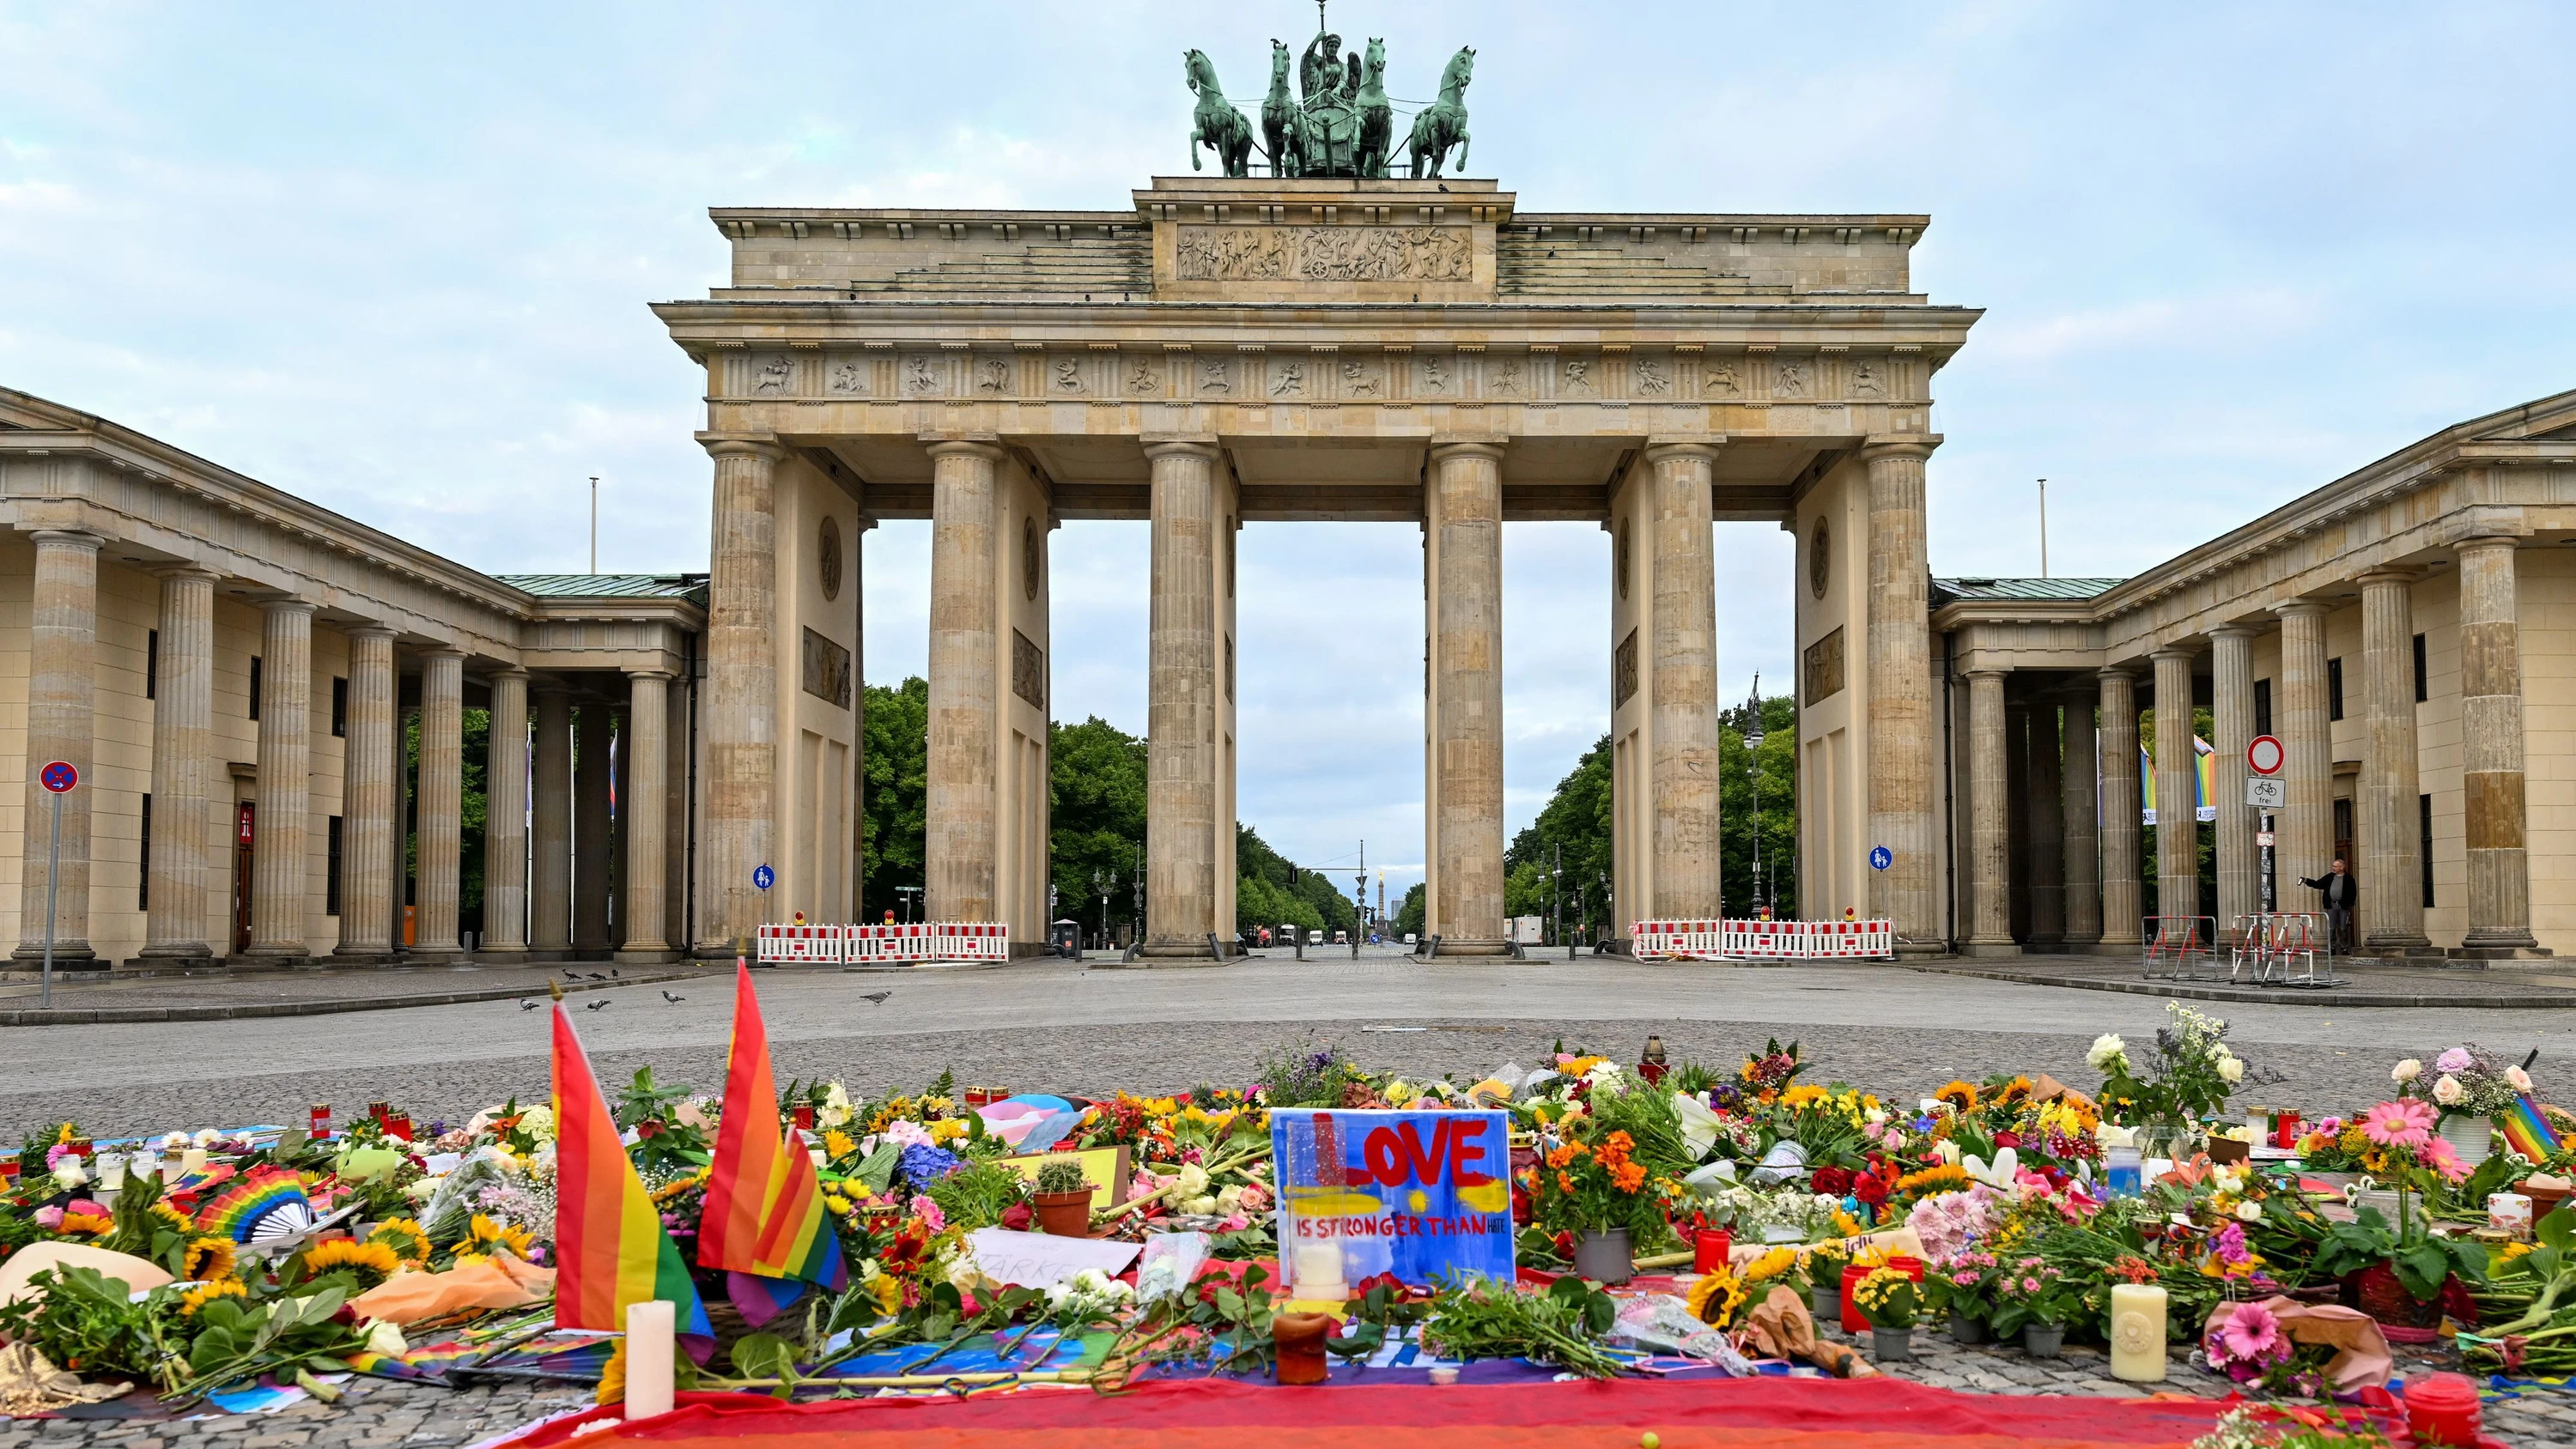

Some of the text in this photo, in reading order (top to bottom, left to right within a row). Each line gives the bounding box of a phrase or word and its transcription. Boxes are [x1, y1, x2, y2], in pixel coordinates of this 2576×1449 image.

[1313, 1113, 1497, 1187] LOVE
[1297, 1214, 1506, 1239] IS STRONGER THAN HATE
